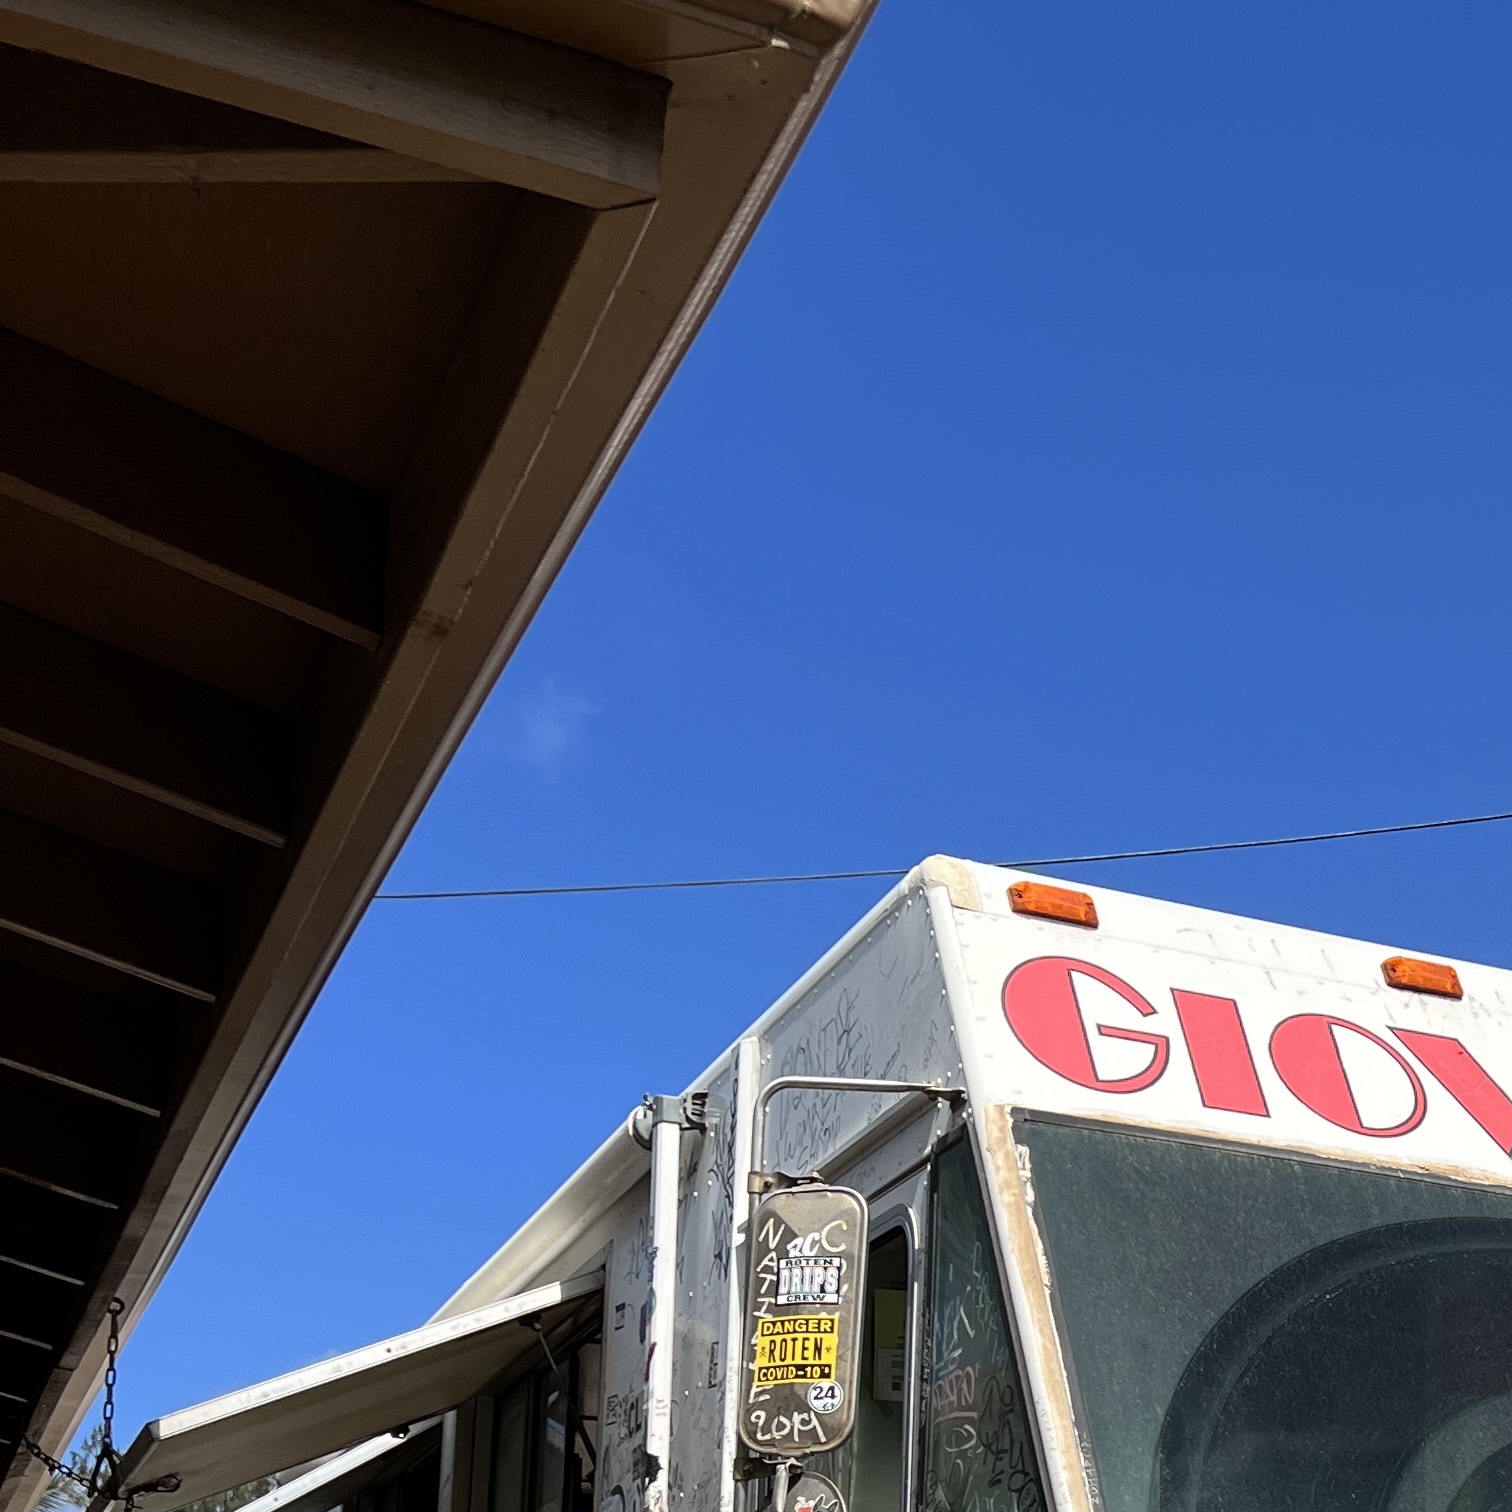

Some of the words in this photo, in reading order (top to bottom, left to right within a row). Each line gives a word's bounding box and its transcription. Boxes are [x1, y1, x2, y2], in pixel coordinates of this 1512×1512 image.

[785, 1258, 834, 1267] ROTEN
[779, 1267, 839, 1295] DRIPS
[786, 1294, 826, 1303] CREW
[763, 1319, 832, 1335] DANGER
[768, 1337, 824, 1363] ROTEN
[813, 1385, 838, 1401] 24
[750, 1409, 827, 1443] 2019
